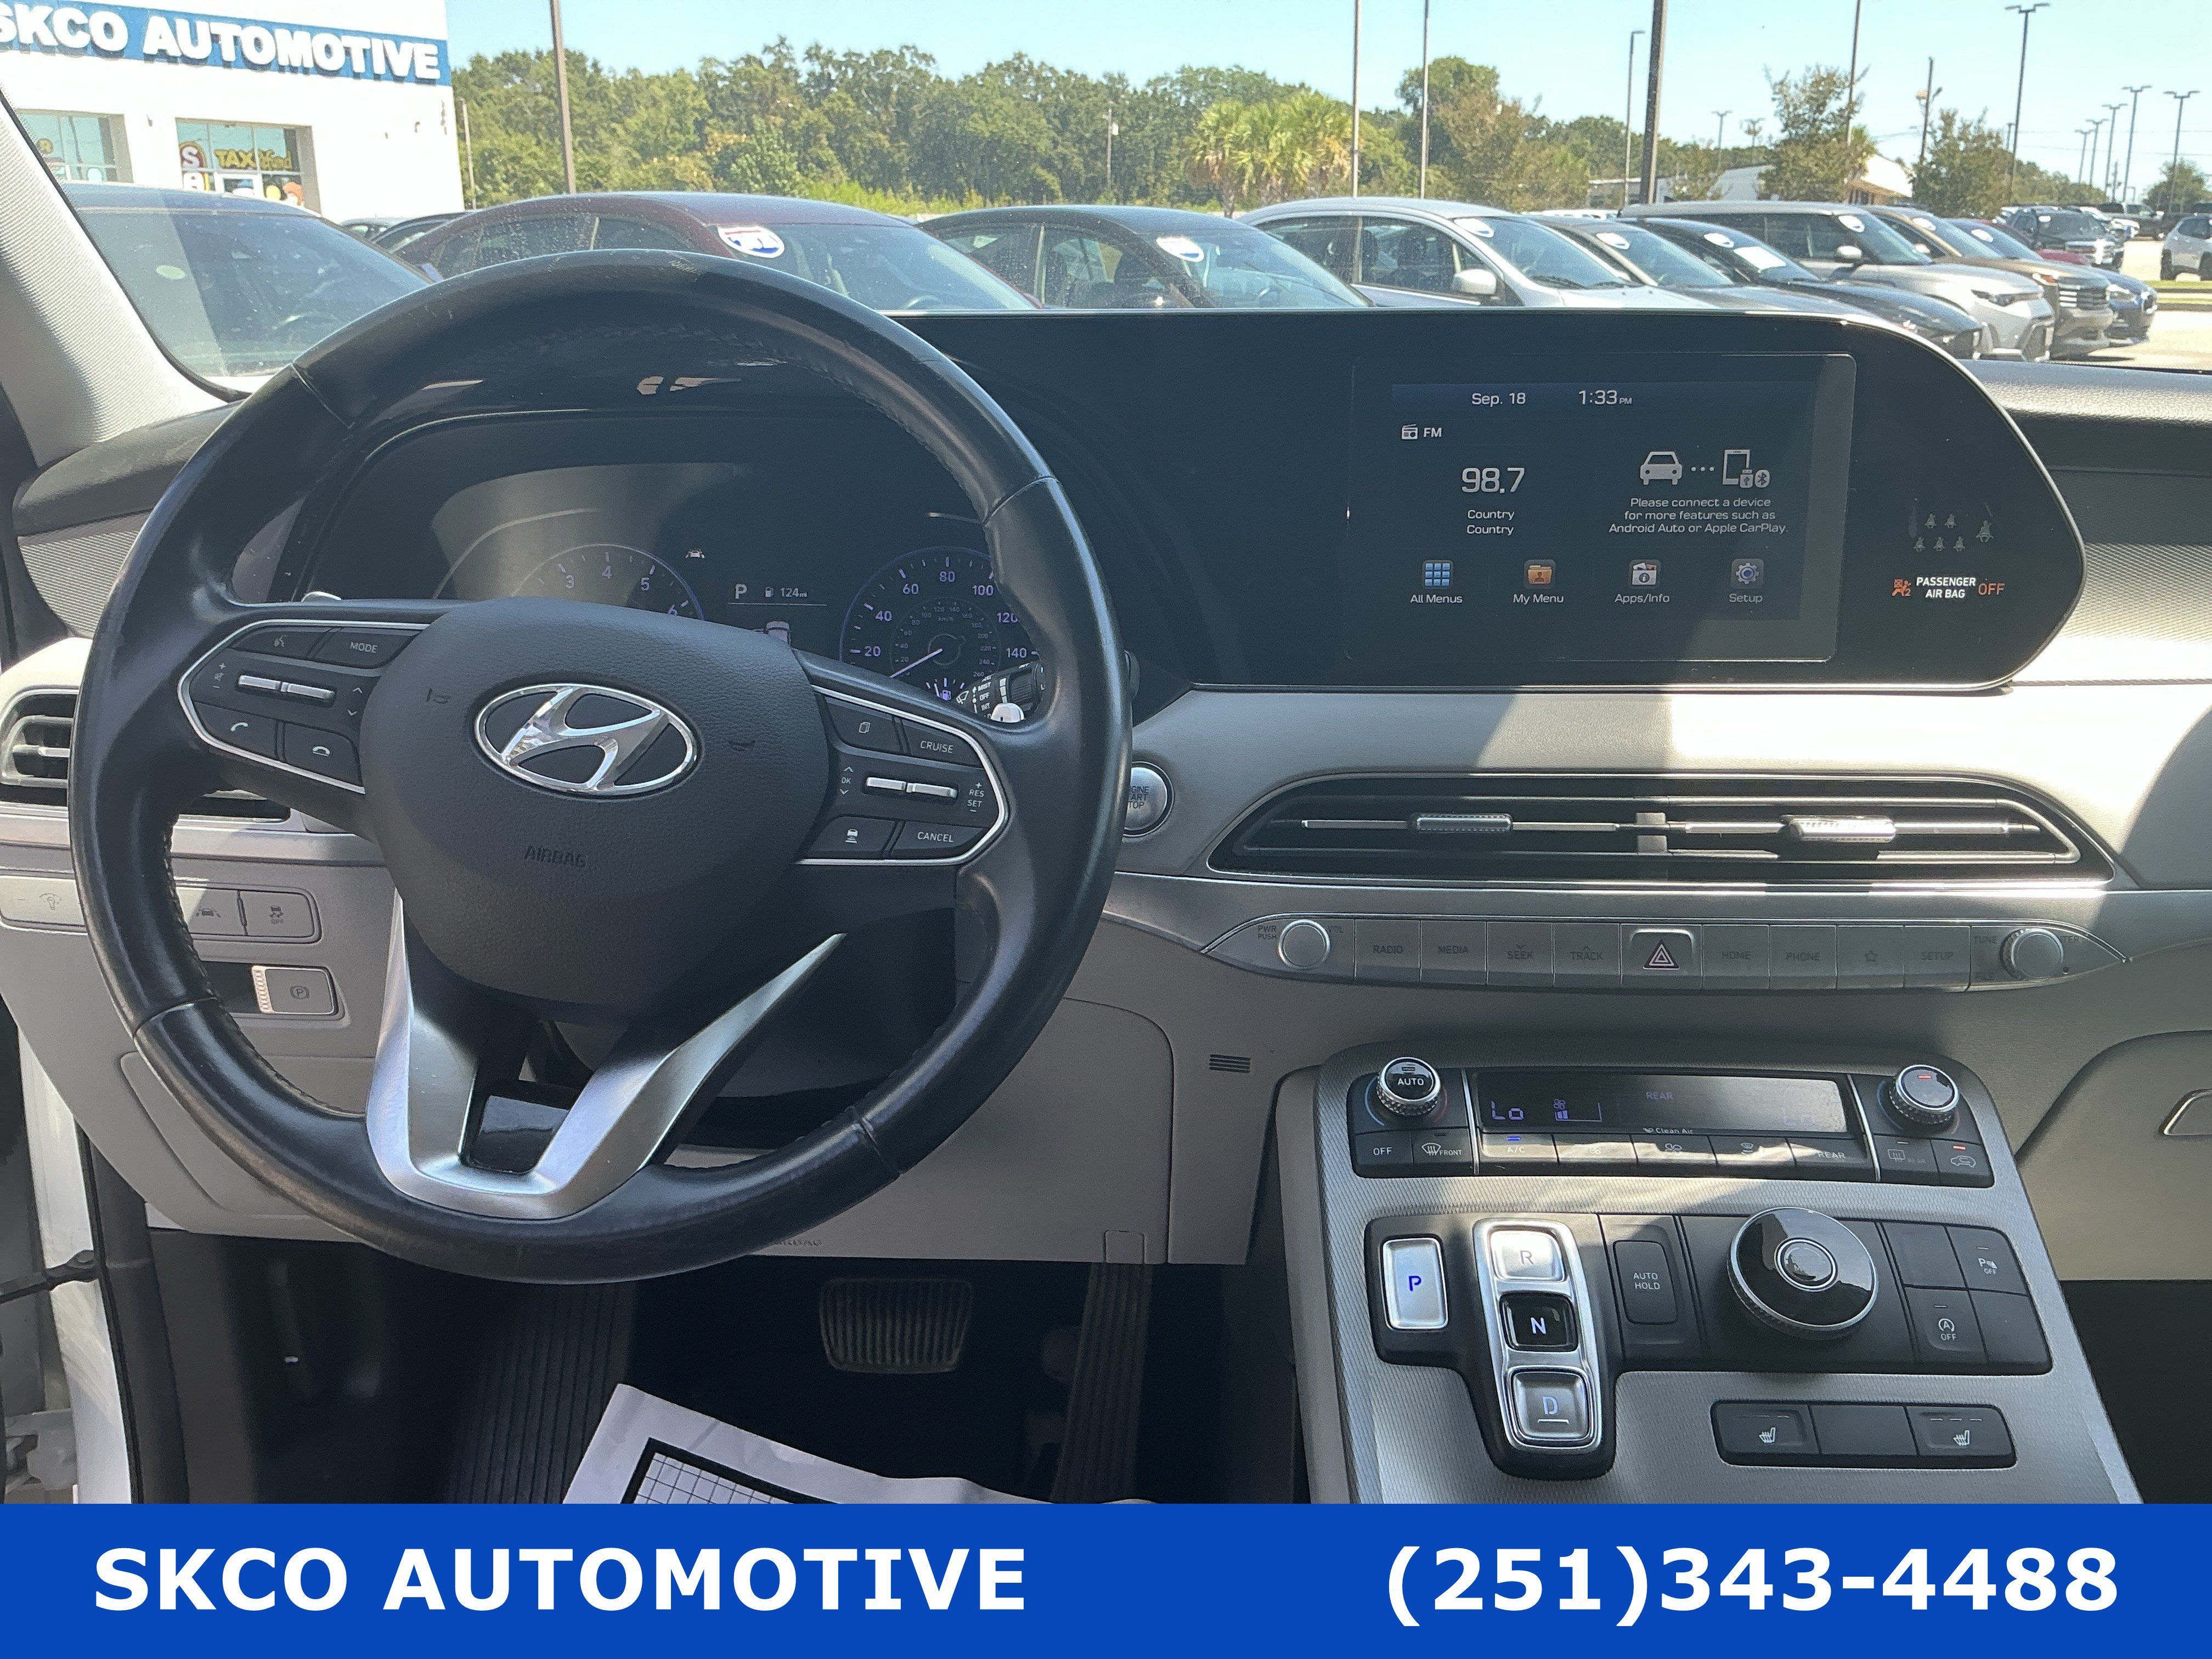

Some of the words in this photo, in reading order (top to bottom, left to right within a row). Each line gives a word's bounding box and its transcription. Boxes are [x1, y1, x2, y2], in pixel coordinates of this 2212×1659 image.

[143, 15, 440, 79] AUTOMOTIVE
[215, 149, 257, 168] TAX
[1471, 392, 1503, 407] Sep.
[1509, 392, 1526, 404] 18
[1424, 427, 1442, 438] FM
[1462, 467, 1525, 493] 98.7
[1630, 498, 1667, 508] Please
[1671, 499, 1719, 508] connect
[1734, 498, 1771, 508] device
[1468, 510, 1515, 522] Country
[1624, 510, 1640, 521] for
[1645, 512, 1675, 521] more
[1679, 510, 1728, 521] features
[1732, 511, 1758, 521] such
[1762, 513, 1776, 521] as
[1467, 525, 1514, 538] Country
[1609, 523, 1654, 534] Android
[1657, 523, 1685, 534] Auto
[1689, 526, 1701, 534] or
[1705, 524, 1737, 536] Apple
[1741, 523, 1788, 537] CarPlay.
[602, 566, 612, 579] 4
[939, 571, 955, 583] 80
[565, 575, 575, 589] 3
[640, 578, 650, 591] 5
[1916, 577, 1976, 586] PASSENGER
[735, 584, 747, 599] P
[902, 584, 919, 595] 60
[972, 585, 994, 596] 100
[1925, 589, 1942, 599] AIR
[1944, 589, 1966, 599] BAG
[1978, 583, 2005, 595] OFF
[1410, 594, 1424, 605] All
[1427, 594, 1463, 605] Menus
[1513, 594, 1529, 607] My
[1533, 594, 1564, 605] Menu
[1615, 593, 1670, 607] Apps/Info
[1729, 593, 1763, 606] Setup
[876, 611, 892, 622] 40
[350, 641, 378, 653] MODE
[864, 646, 881, 657] 20
[1005, 647, 1028, 658] 140
[979, 692, 990, 701] OFF
[919, 740, 954, 753] CRUISE
[969, 789, 985, 798] RES
[967, 799, 982, 808] SET
[1128, 800, 1144, 809] TOP
[917, 831, 954, 843] CANCEL
[525, 845, 586, 867] AIRBAG
[1373, 945, 1404, 953] RADIO
[1437, 946, 1469, 955] MEDIA
[1507, 951, 1533, 961] SEEK
[1570, 952, 1603, 961] TRACK
[1722, 951, 1751, 960] HOME
[1786, 952, 1820, 962] PHONE
[1921, 952, 1954, 961] SETUP
[1397, 1077, 1424, 1086] AUTO
[1491, 1101, 1523, 1120] Lo
[1373, 1146, 1392, 1155] OFF
[1818, 1151, 1846, 1159] REAR
[1520, 1250, 1533, 1263] R
[1409, 1276, 1421, 1291] P
[1635, 1282, 1660, 1290] HOLD
[1531, 1317, 1547, 1334] N
[1543, 1396, 1559, 1415] D
